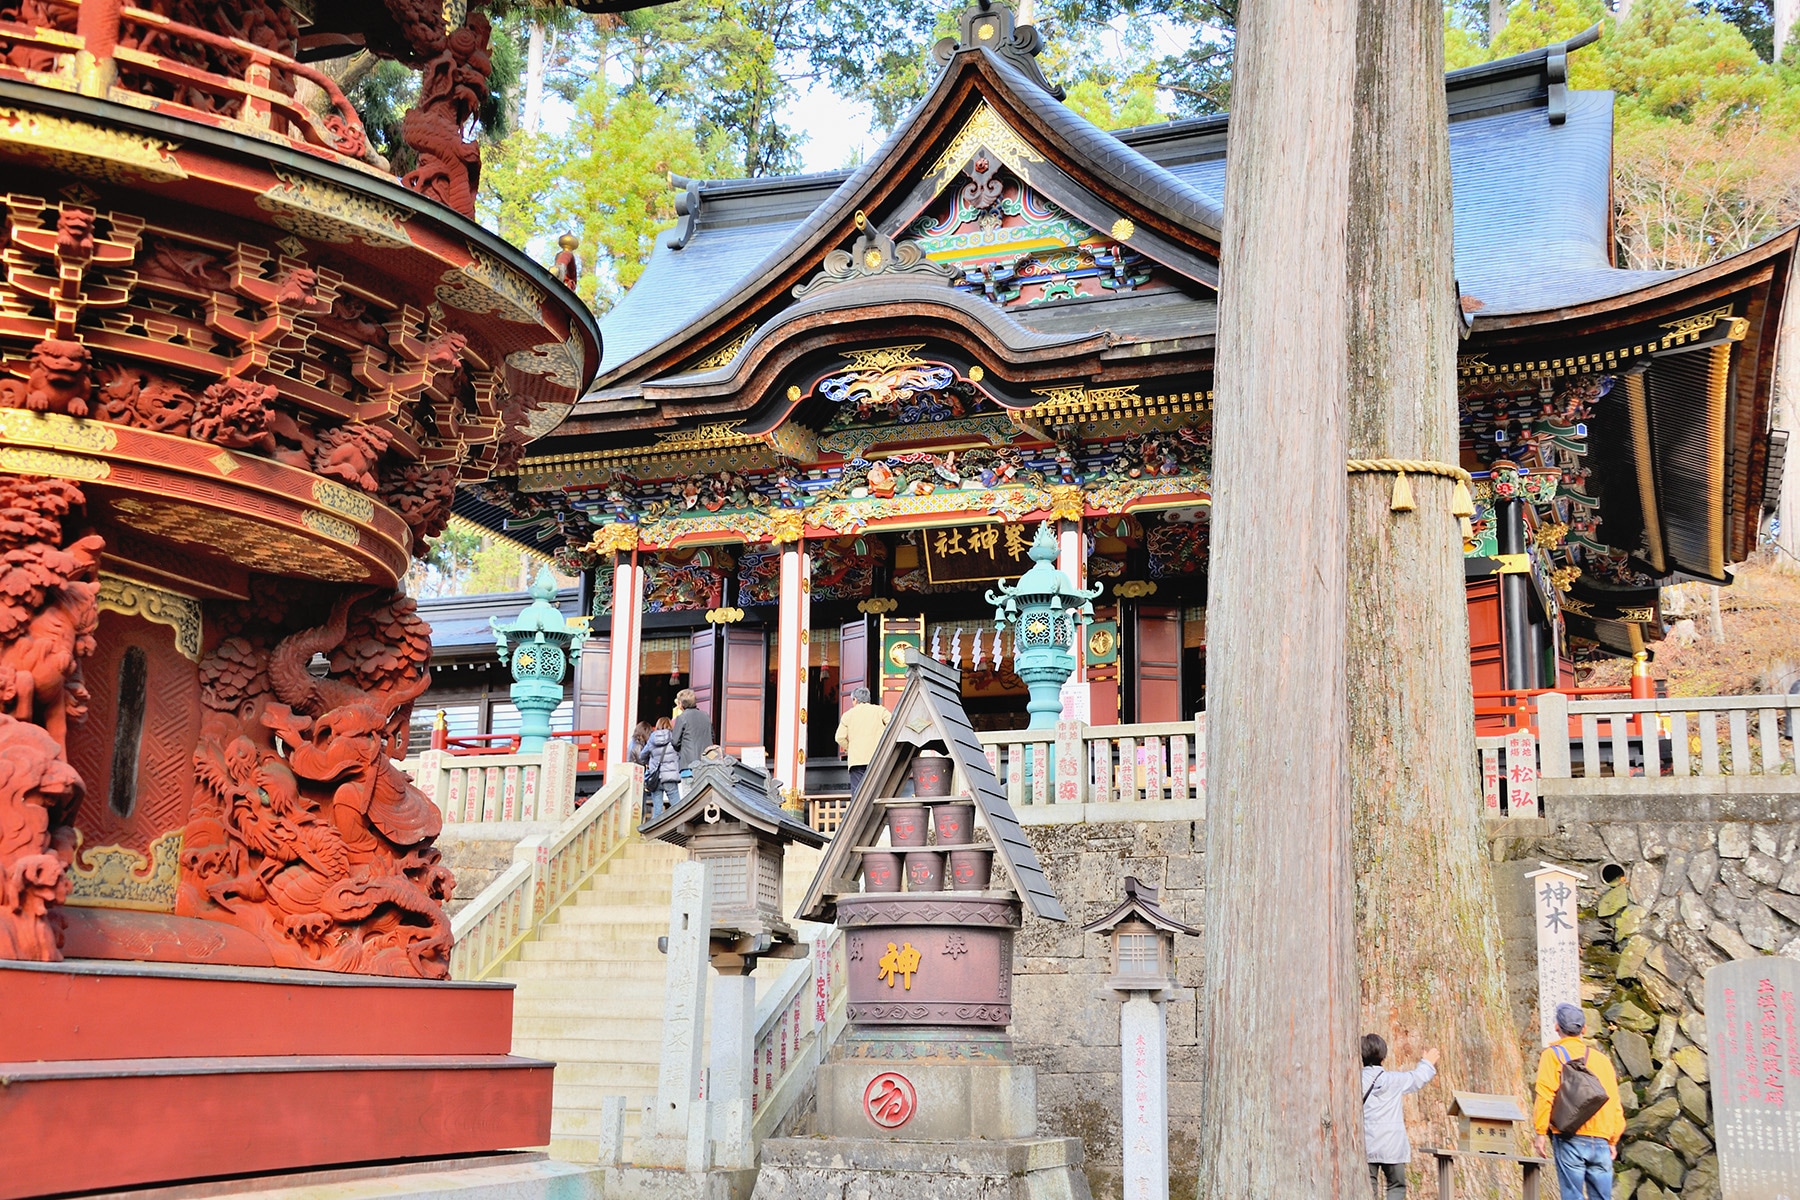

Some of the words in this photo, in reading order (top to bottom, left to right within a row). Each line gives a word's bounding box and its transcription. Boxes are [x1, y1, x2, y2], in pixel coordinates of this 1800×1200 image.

[1510, 764, 1534, 808] 松弘
[1539, 881, 1574, 934] 神木
[877, 942, 922, 990] 神
